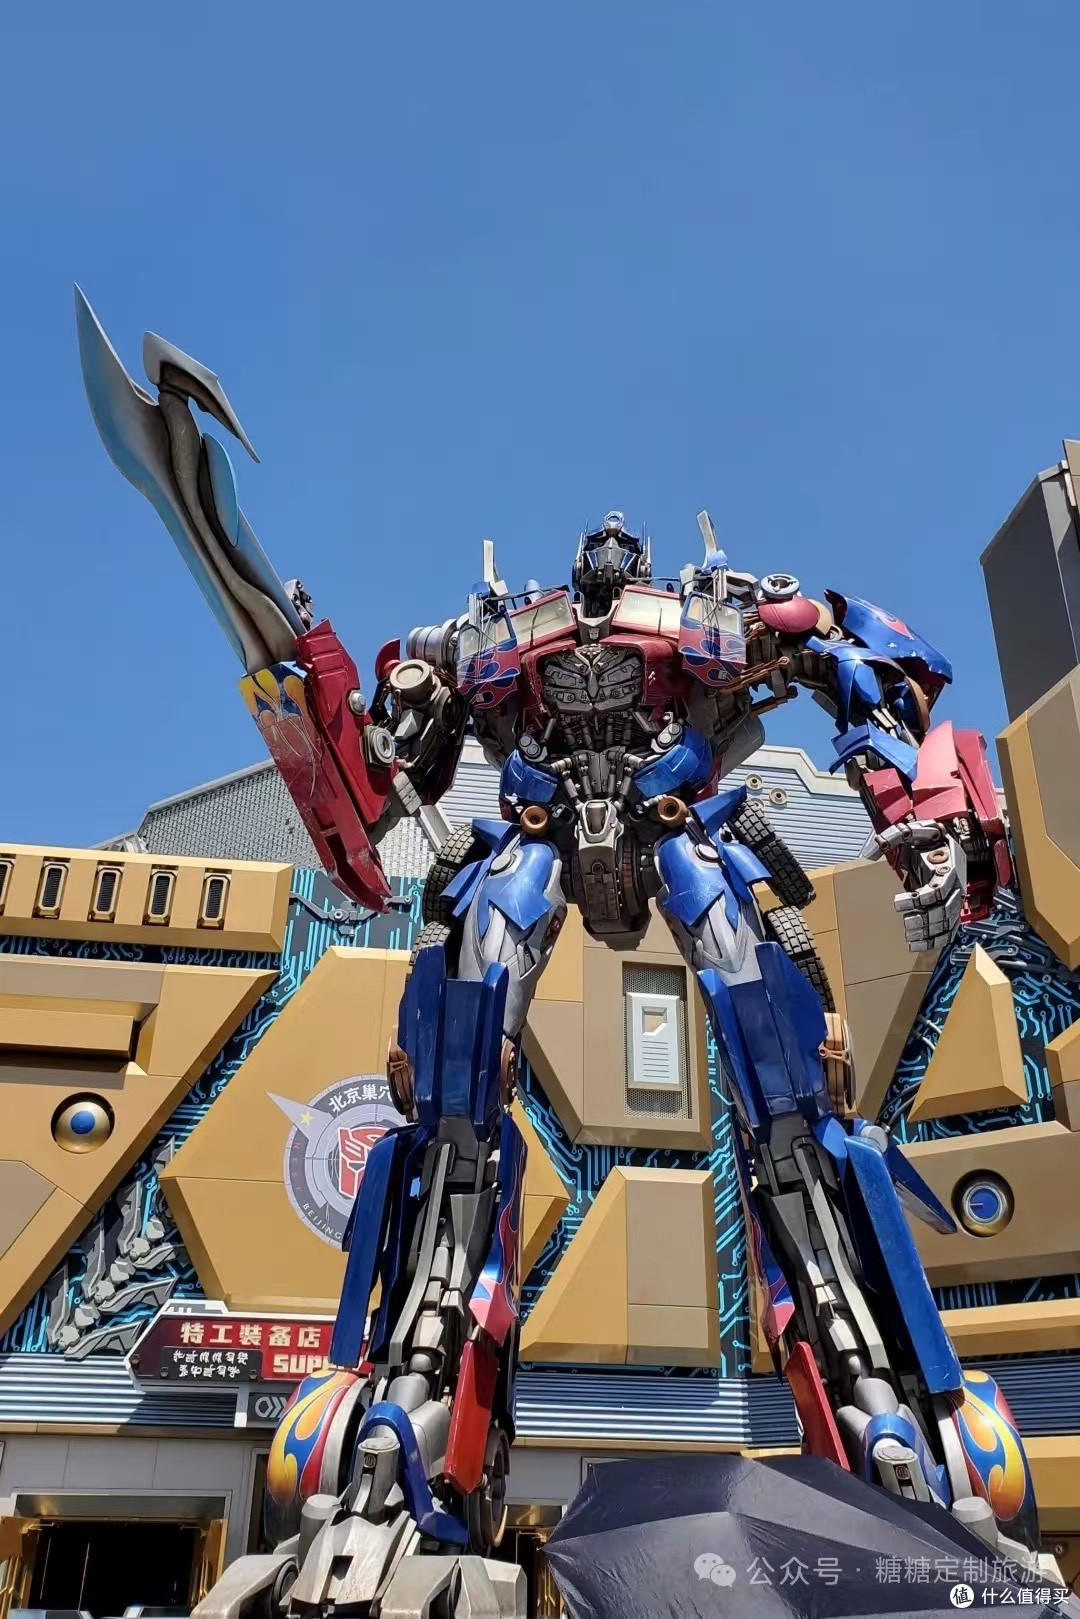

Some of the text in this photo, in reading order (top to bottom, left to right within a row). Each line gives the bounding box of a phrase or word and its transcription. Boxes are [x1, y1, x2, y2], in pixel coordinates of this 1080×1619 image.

[303, 1203, 342, 1240] BEIJING
[180, 1322, 321, 1348] 特工装备店
